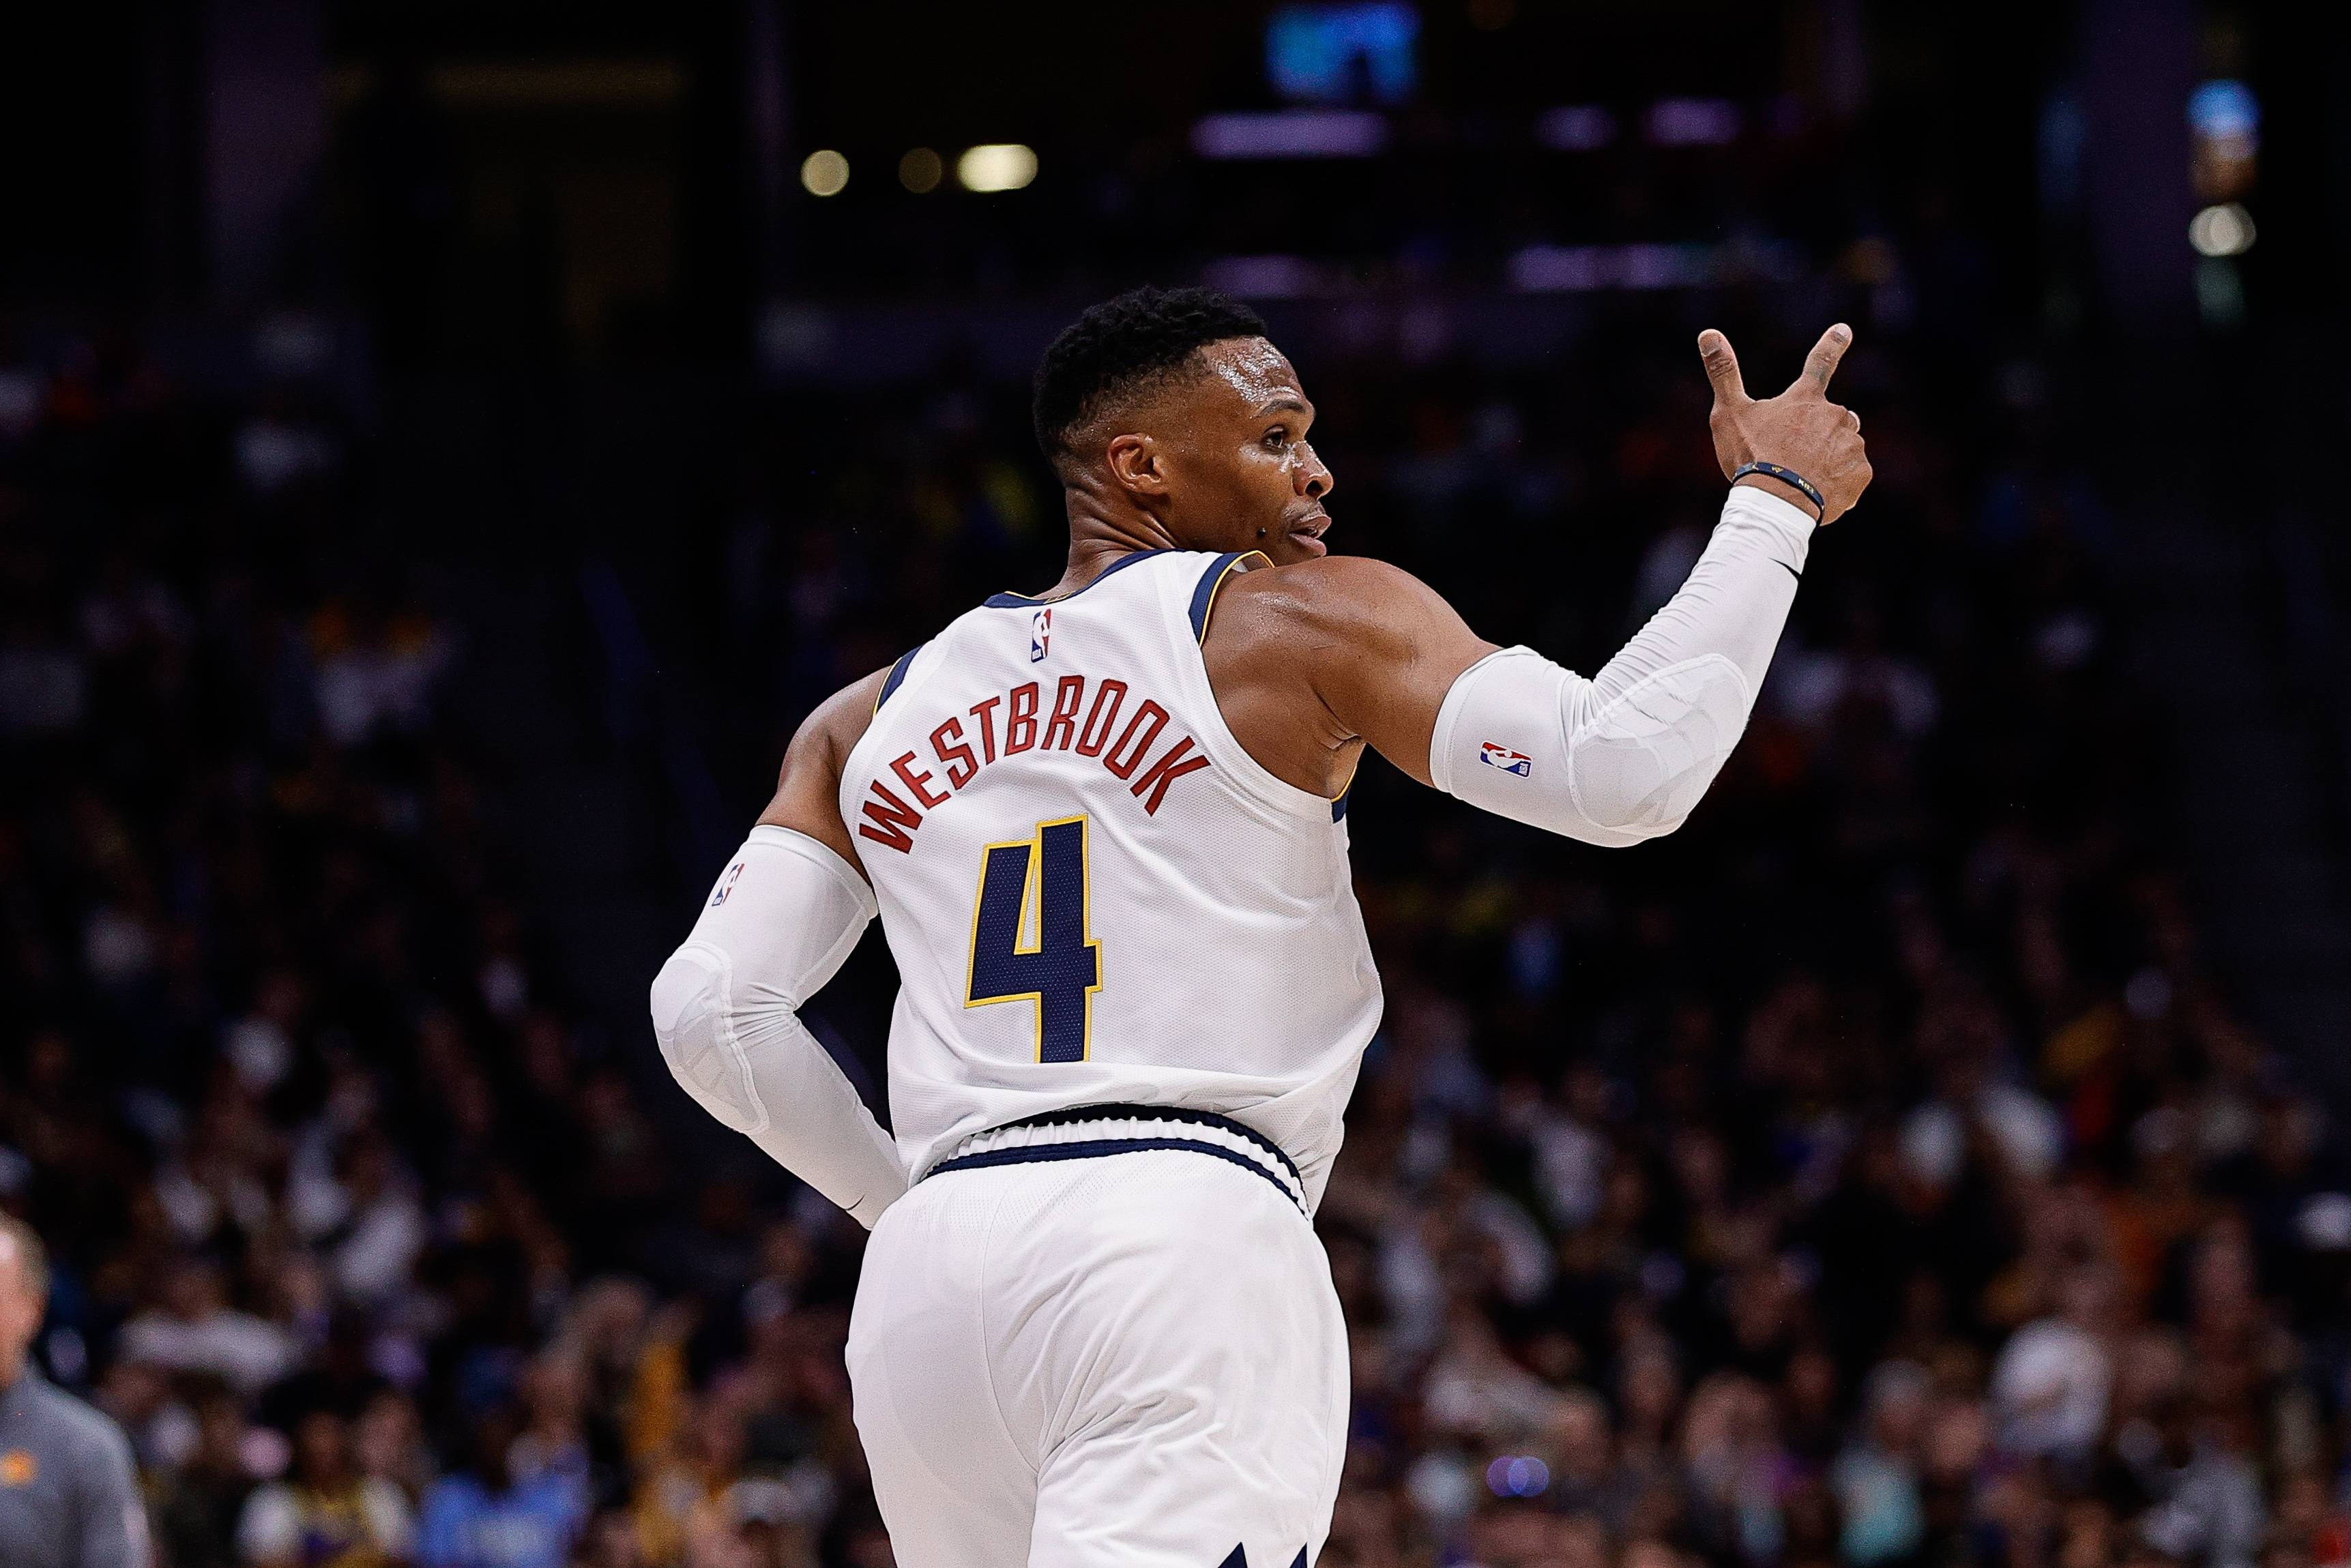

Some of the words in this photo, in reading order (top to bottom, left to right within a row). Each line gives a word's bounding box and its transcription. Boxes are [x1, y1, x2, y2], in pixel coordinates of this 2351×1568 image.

[859, 675, 1212, 855] WESTBROOK
[1518, 763, 1529, 775] NBA
[963, 813, 1104, 1064] 4
